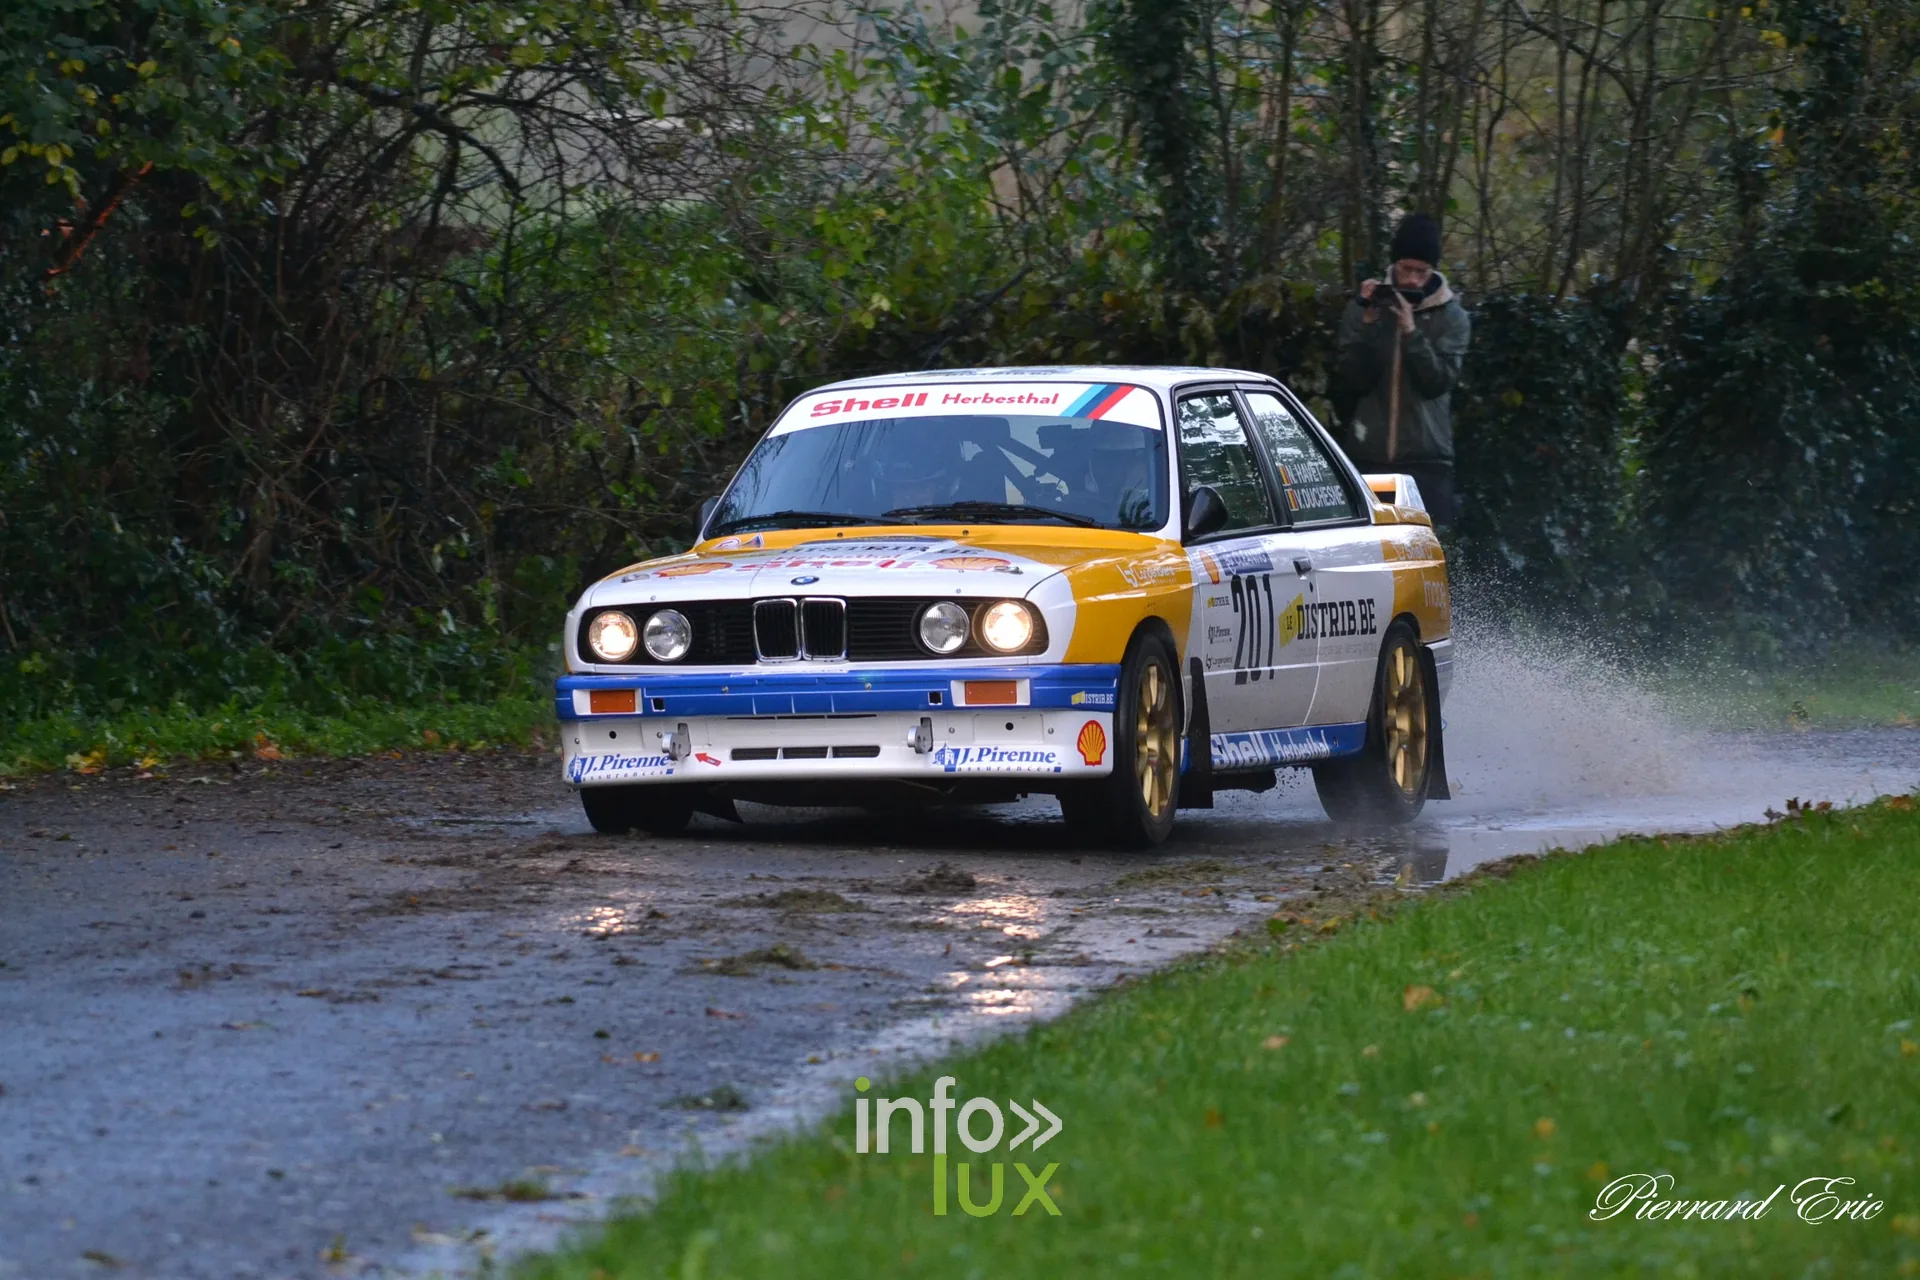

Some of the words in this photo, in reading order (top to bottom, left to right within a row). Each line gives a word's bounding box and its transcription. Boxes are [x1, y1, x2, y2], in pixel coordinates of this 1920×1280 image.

[810, 392, 929, 418] Shell
[941, 392, 1060, 405] Herbesthal
[1231, 573, 1275, 686] 201
[1296, 598, 1377, 640] DISTRIB.BE
[584, 753, 670, 775] J.Pirenne
[958, 746, 1057, 765] J.Pirenne
[1210, 731, 1271, 770] Shell
[1268, 729, 1331, 761] Herbesthal
